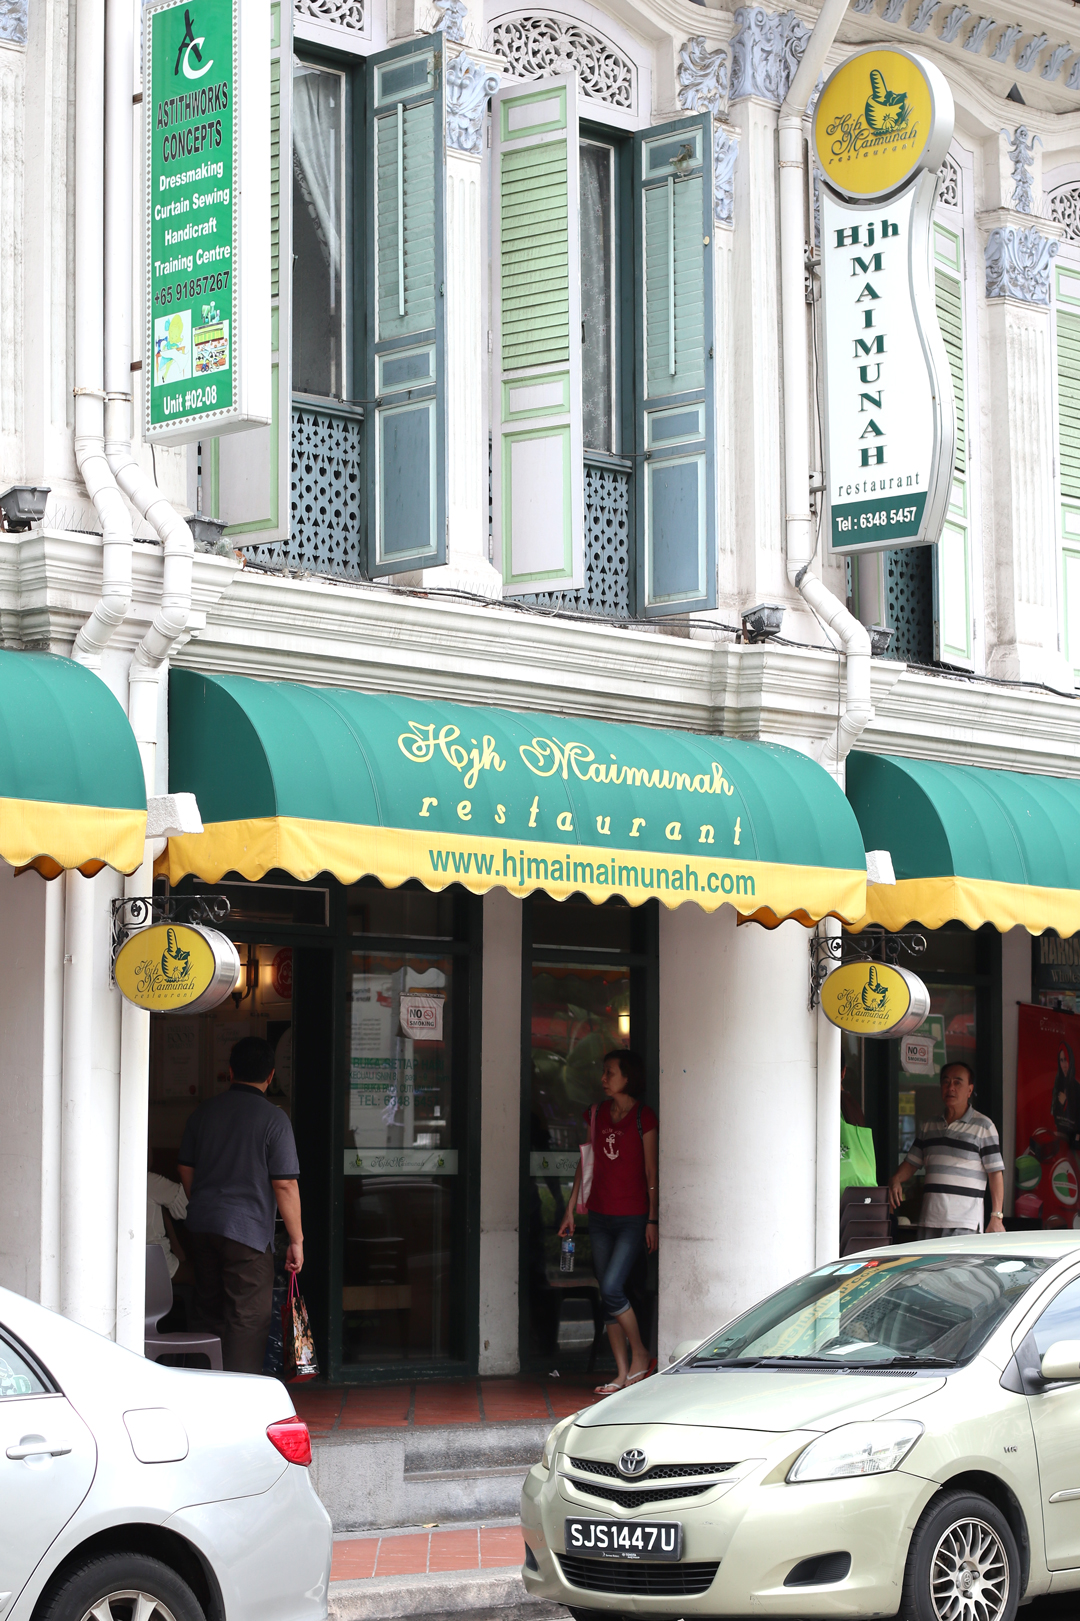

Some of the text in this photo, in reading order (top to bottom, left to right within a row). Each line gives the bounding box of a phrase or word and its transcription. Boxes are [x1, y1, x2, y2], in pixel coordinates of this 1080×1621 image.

[156, 81, 228, 130] ASTITHWORKS
[163, 119, 222, 163] CONCEPTS
[829, 140, 916, 165] restaurant
[831, 121, 920, 155] Maimunah
[159, 161, 224, 191] Dressmaking
[154, 188, 230, 221] Curtain Sewing
[164, 217, 217, 246] Handicraft
[834, 219, 900, 249] Hjh
[154, 245, 231, 277] Training Centre
[154, 270, 230, 306] +65 91857267
[850, 252, 888, 467] MAIMUNAH
[163, 385, 217, 415] Unit #02-08
[838, 471, 920, 497] restaurant
[860, 511, 887, 528] 6348
[890, 506, 917, 524] 5457
[397, 720, 734, 796] Hjh Maimunah
[418, 795, 742, 845] restaurant
[429, 848, 756, 896] www.hjmaimaimunah.com
[136, 976, 195, 993] Maimunah
[409, 1009, 422, 1018] NO
[837, 1002, 892, 1020] Maimunah
[382, 1058, 418, 1070] SETIAP
[907, 1046, 918, 1055] NO
[383, 1095, 410, 1107] 6348
[571, 1523, 675, 1552] SJS1447U
